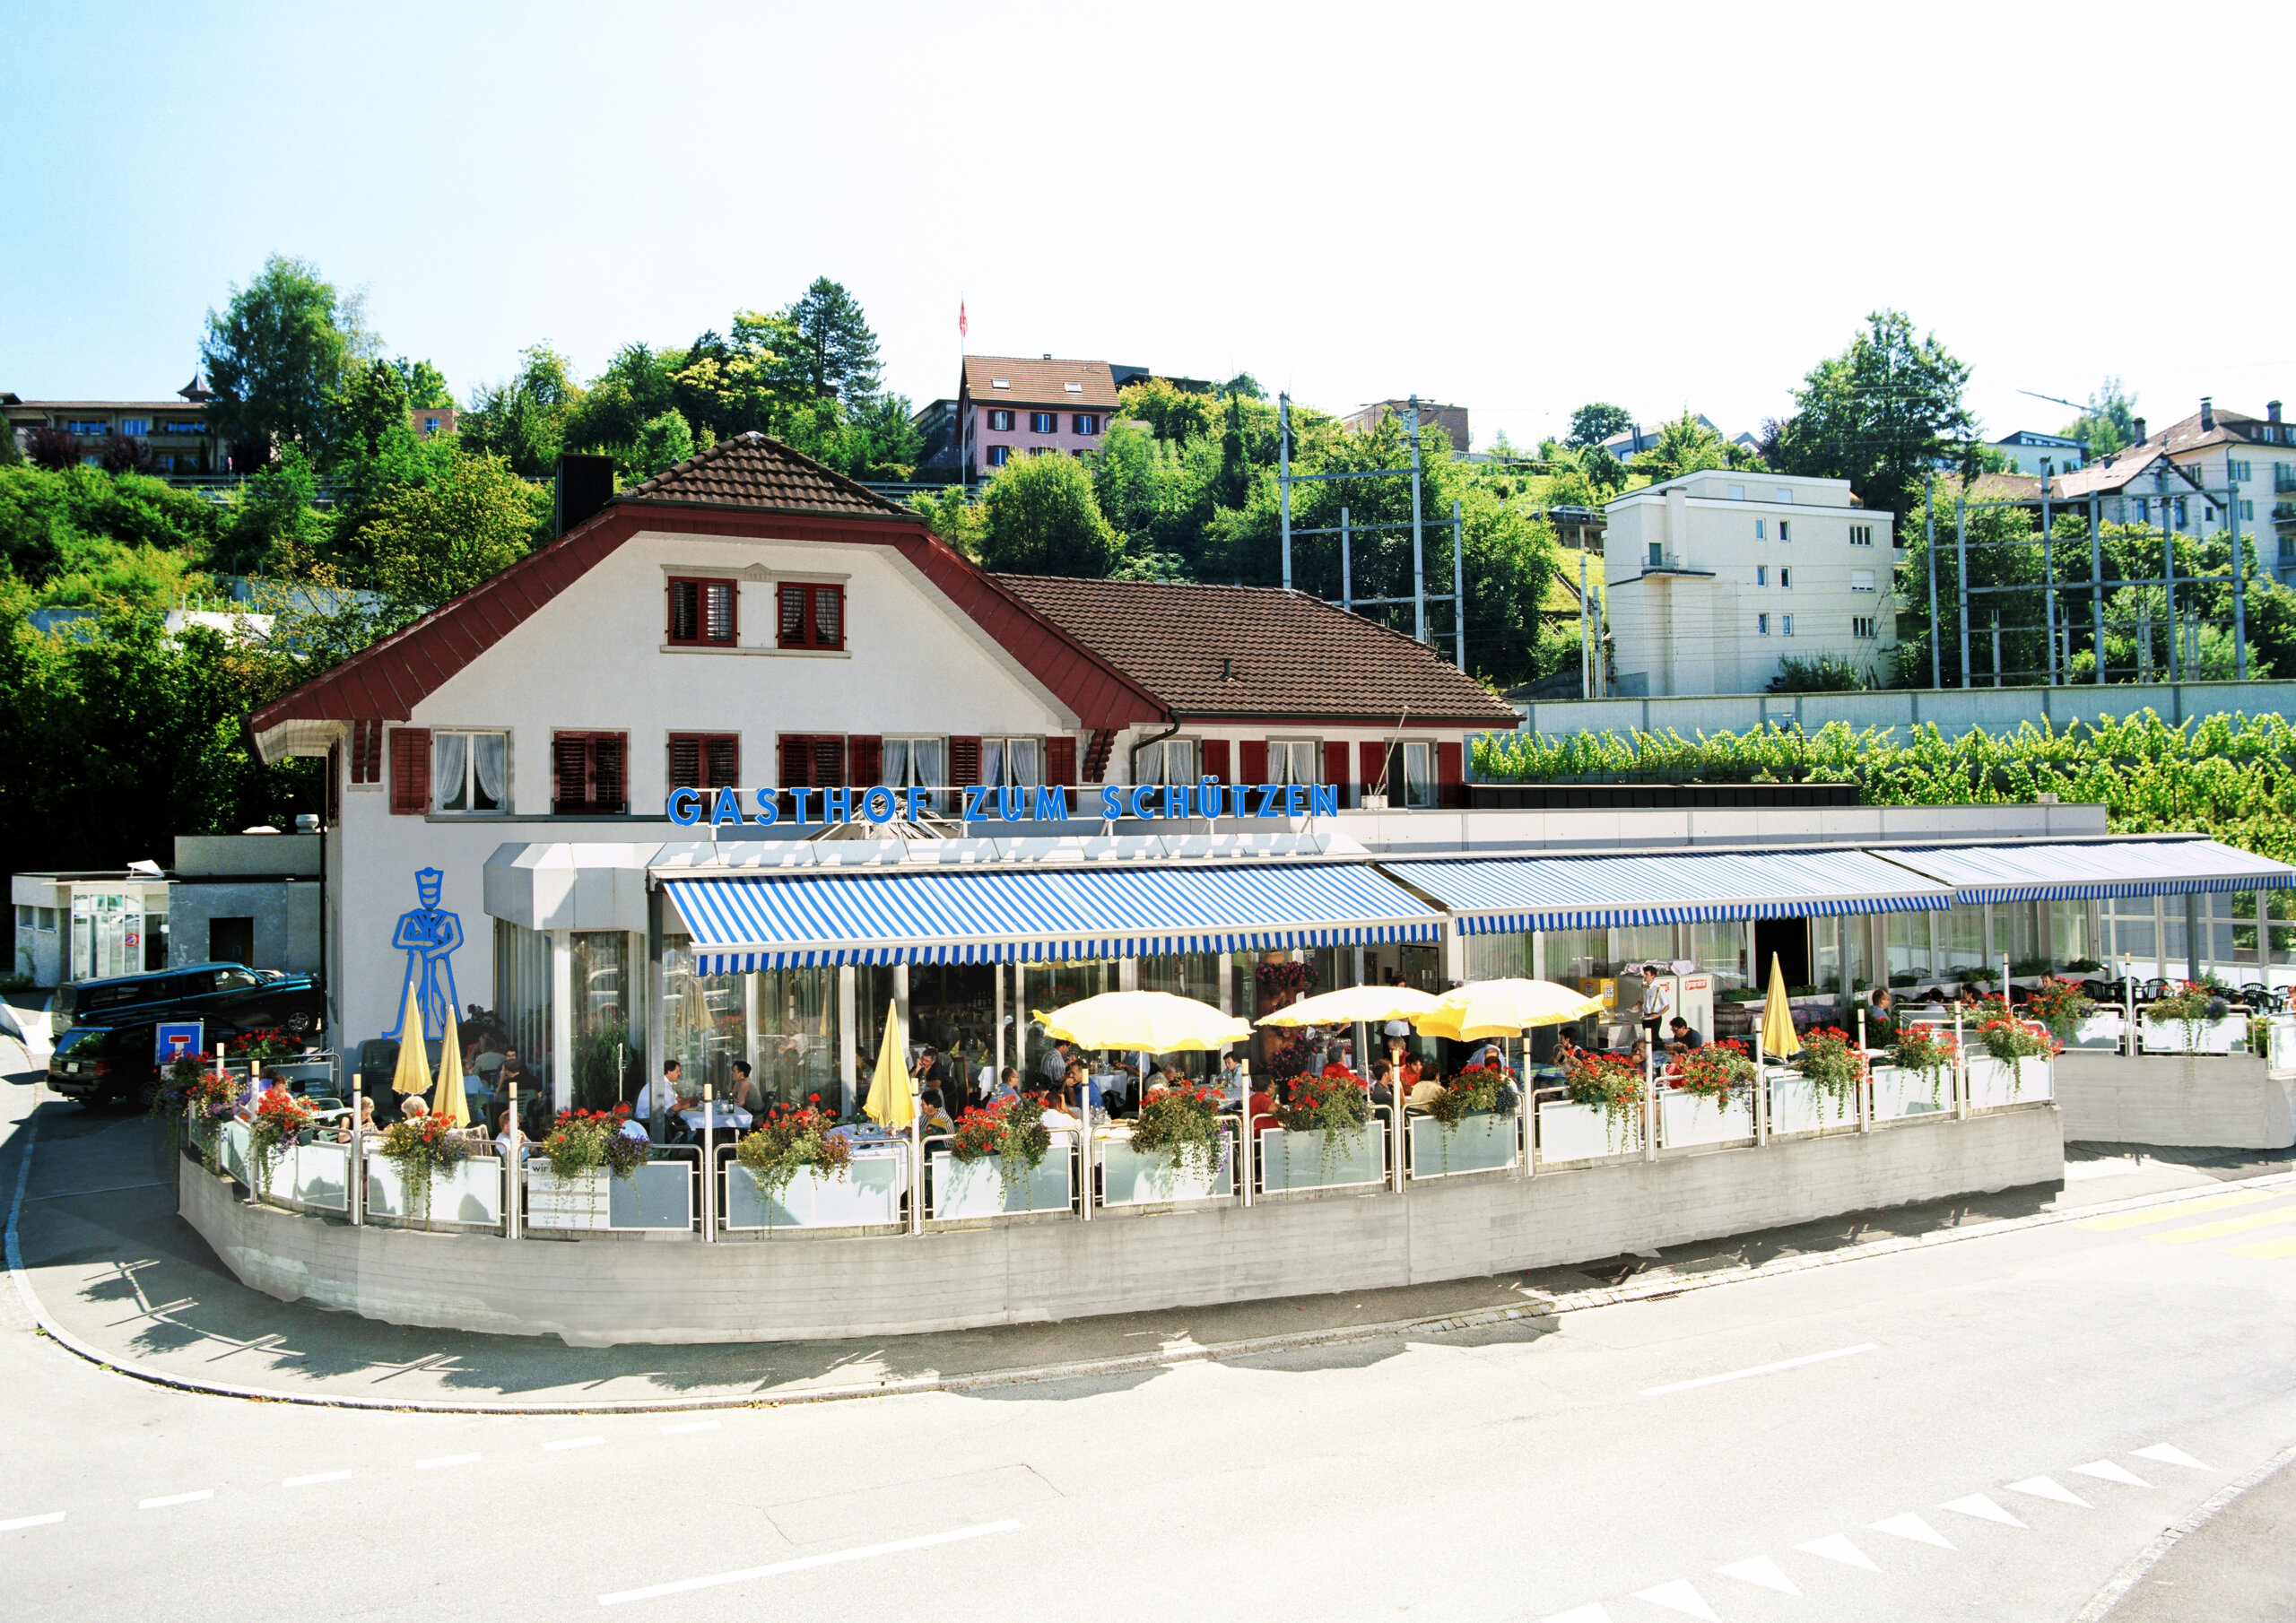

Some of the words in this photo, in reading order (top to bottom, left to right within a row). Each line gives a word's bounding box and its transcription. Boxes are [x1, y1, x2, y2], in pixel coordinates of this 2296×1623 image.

[667, 785, 926, 826] GASTHOF
[963, 785, 1068, 822] ZUM
[1100, 775, 1338, 820] SCHÜTZEN
